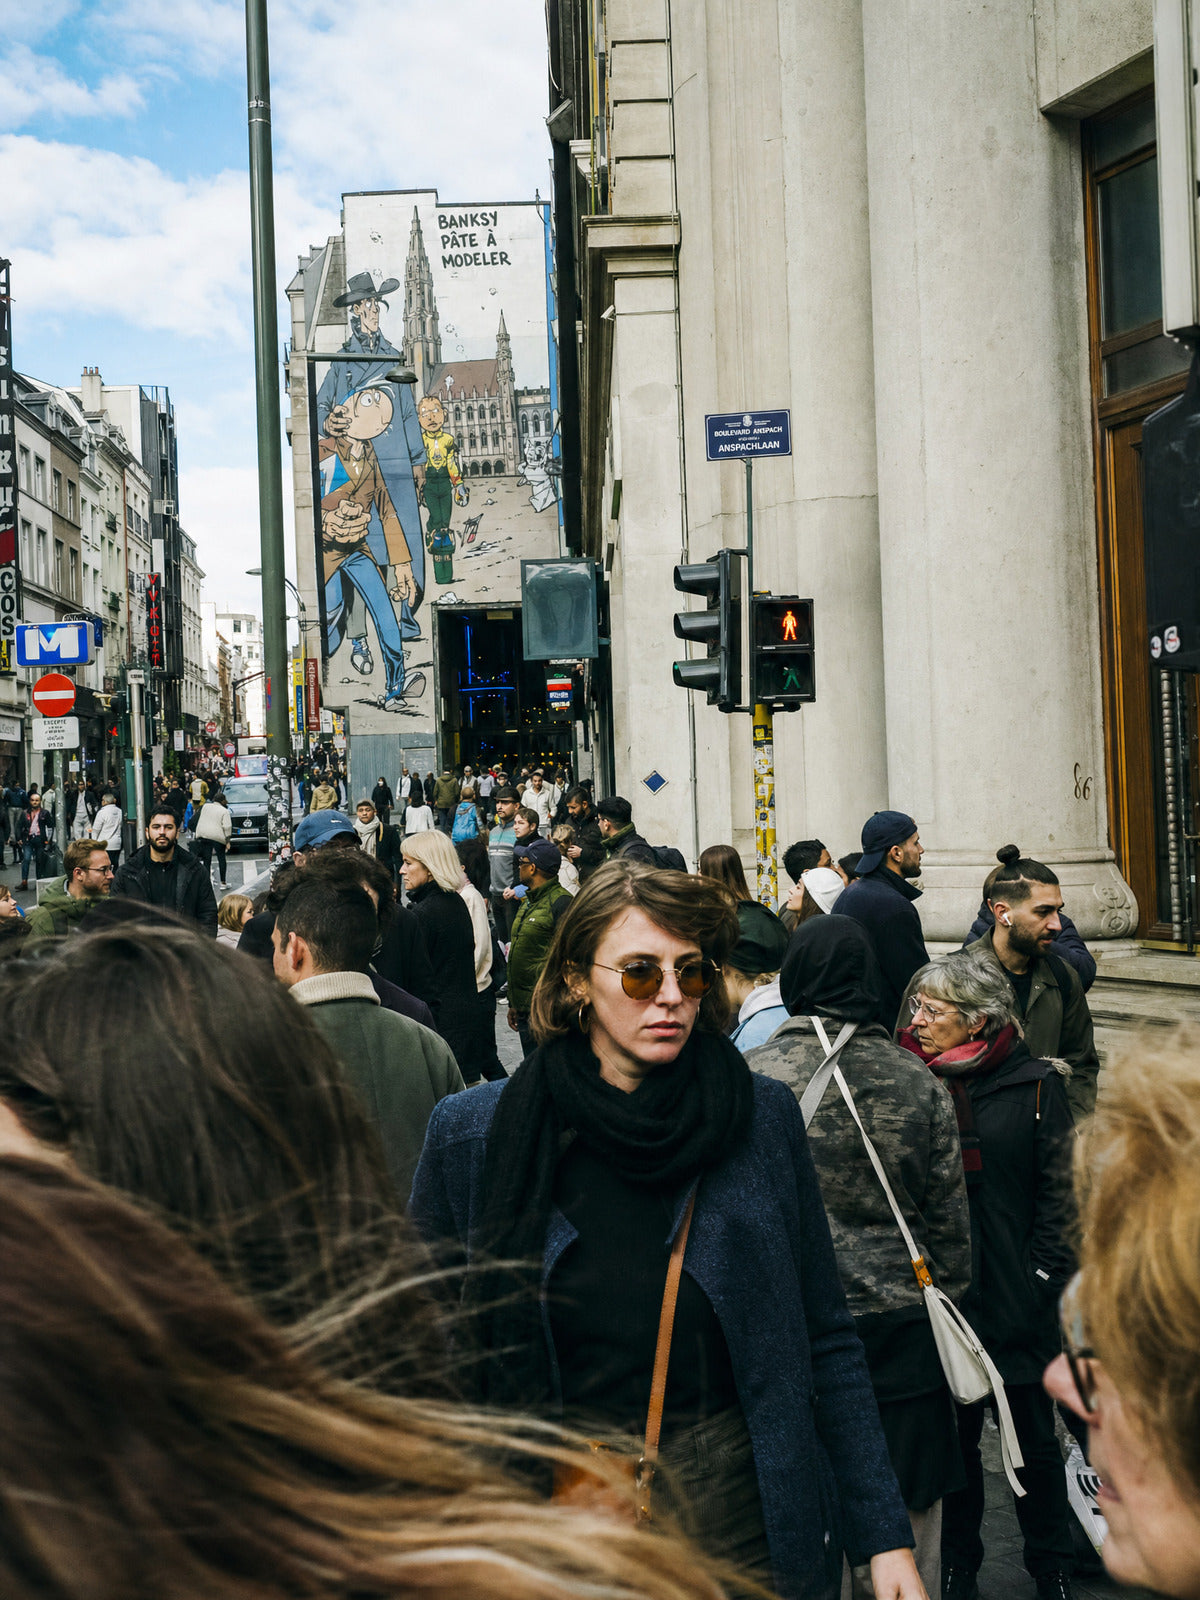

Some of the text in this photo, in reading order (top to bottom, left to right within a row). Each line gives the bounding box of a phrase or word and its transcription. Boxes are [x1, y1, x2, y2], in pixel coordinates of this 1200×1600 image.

[438, 211, 498, 229] BANKSY
[440, 229, 497, 249] PÂTE À
[441, 251, 512, 269] MODELER
[714, 426, 782, 437] BOULEVARD ANSPACH
[718, 441, 780, 453] ANSPACHLAAN
